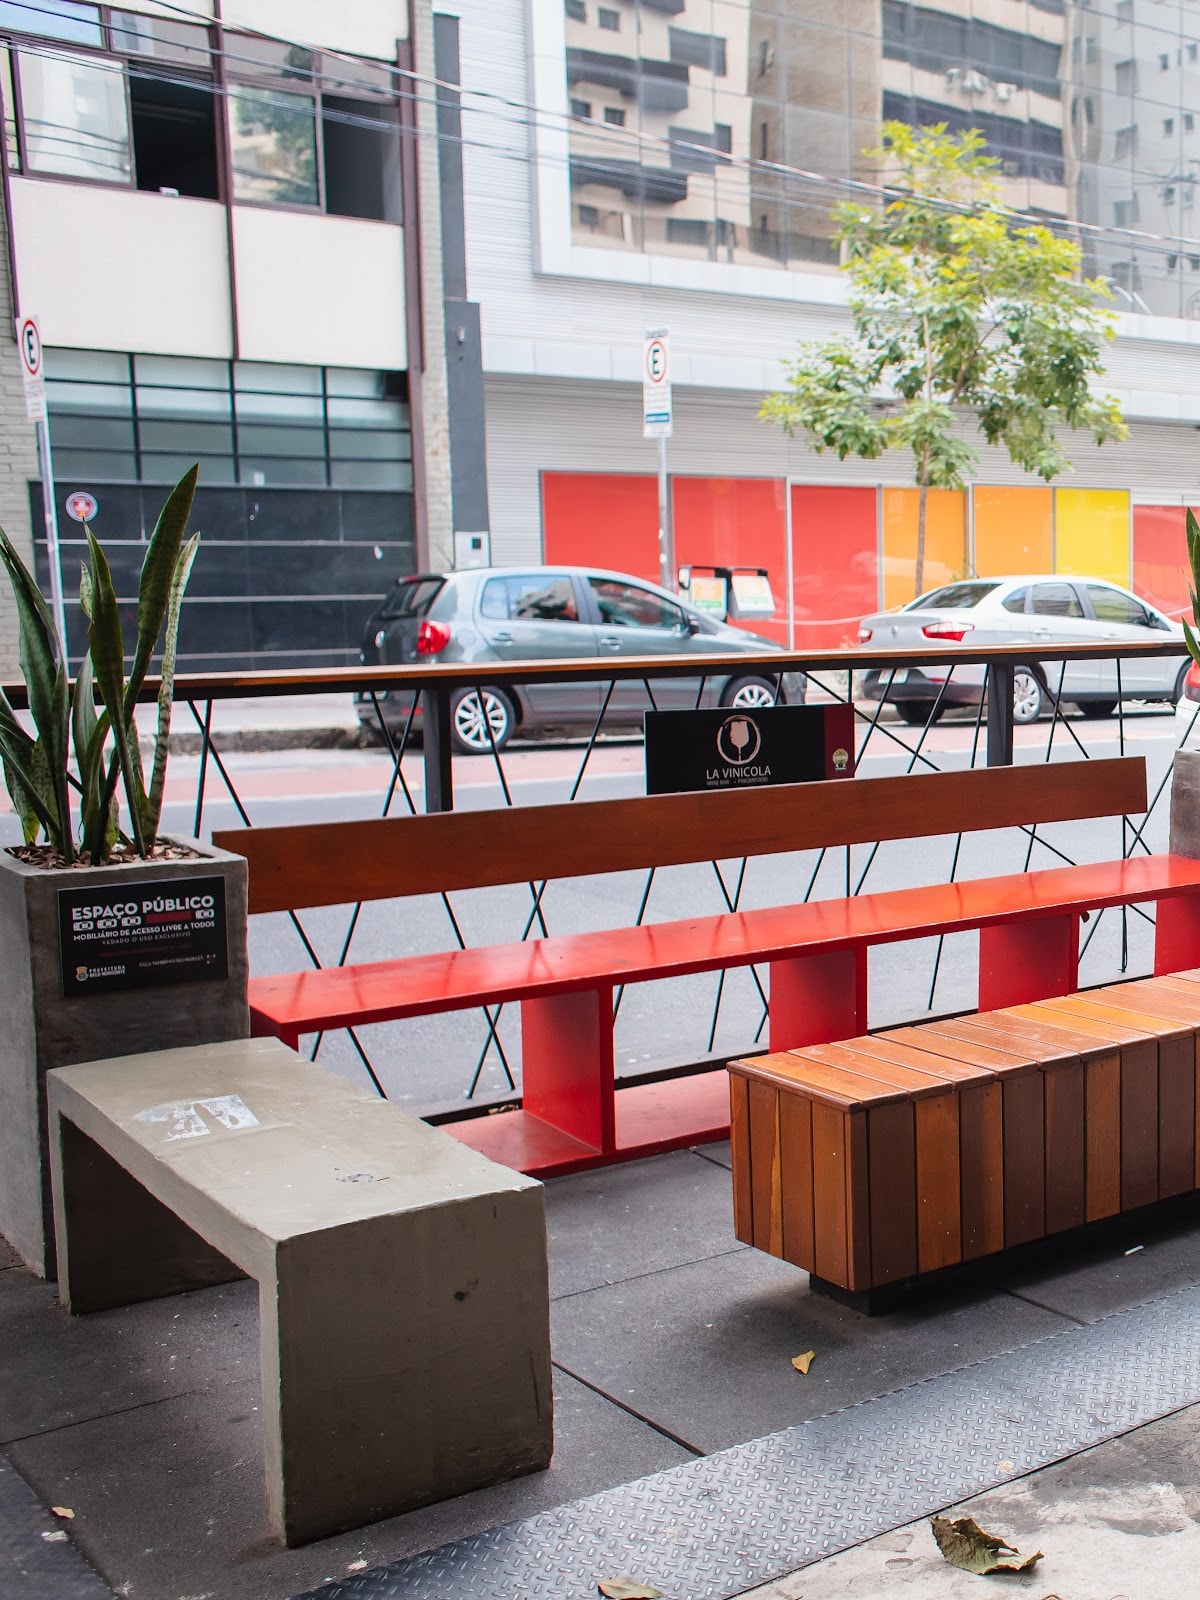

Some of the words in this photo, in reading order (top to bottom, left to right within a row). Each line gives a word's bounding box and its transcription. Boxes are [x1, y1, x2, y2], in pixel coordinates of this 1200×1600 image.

[27, 330, 36, 364] E
[652, 349, 660, 374] E
[706, 769, 719, 780] LA
[722, 765, 772, 779] VINICOLA
[72, 903, 138, 920] ESPAÇO
[142, 895, 214, 914] PÚBLICO
[74, 929, 119, 942] MOBILIÁRIO
[131, 926, 160, 935] ACESSO
[161, 924, 182, 933] LIVRE
[190, 921, 215, 929] TODOS
[102, 937, 130, 945] VEDADO
[139, 934, 153, 942] USO
[154, 931, 191, 940] EXCLUSIVO
